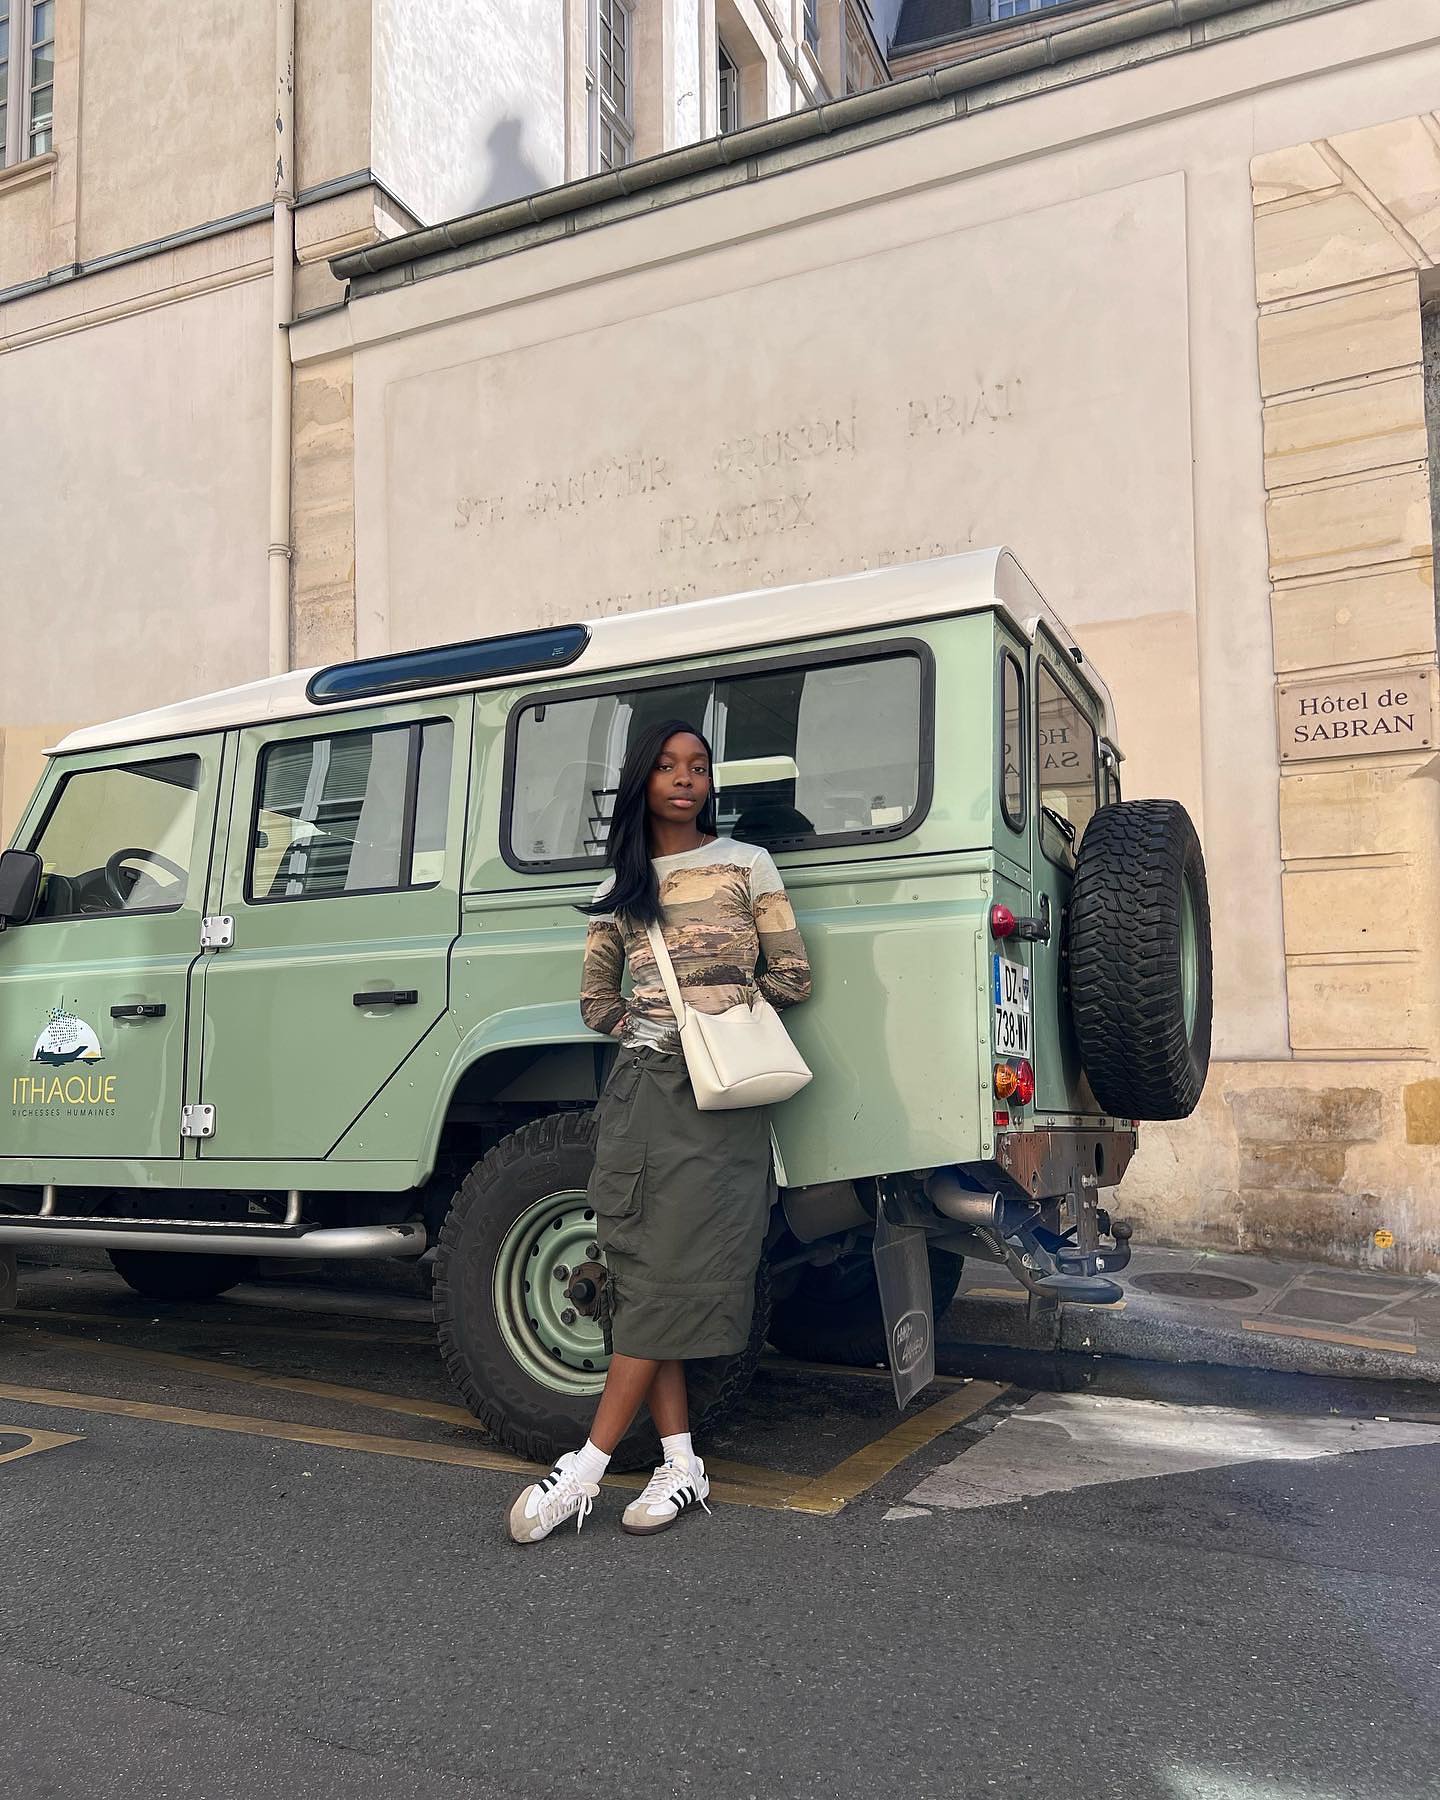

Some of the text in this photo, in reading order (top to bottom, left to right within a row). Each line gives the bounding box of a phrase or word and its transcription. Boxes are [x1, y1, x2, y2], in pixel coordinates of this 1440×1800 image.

[1299, 689, 1408, 716] Hôtel de
[1294, 714, 1415, 743] SABRAN
[12, 1075, 117, 1105] ITHAQUE
[12, 1108, 116, 1117] RICHESSES HUMAINES
